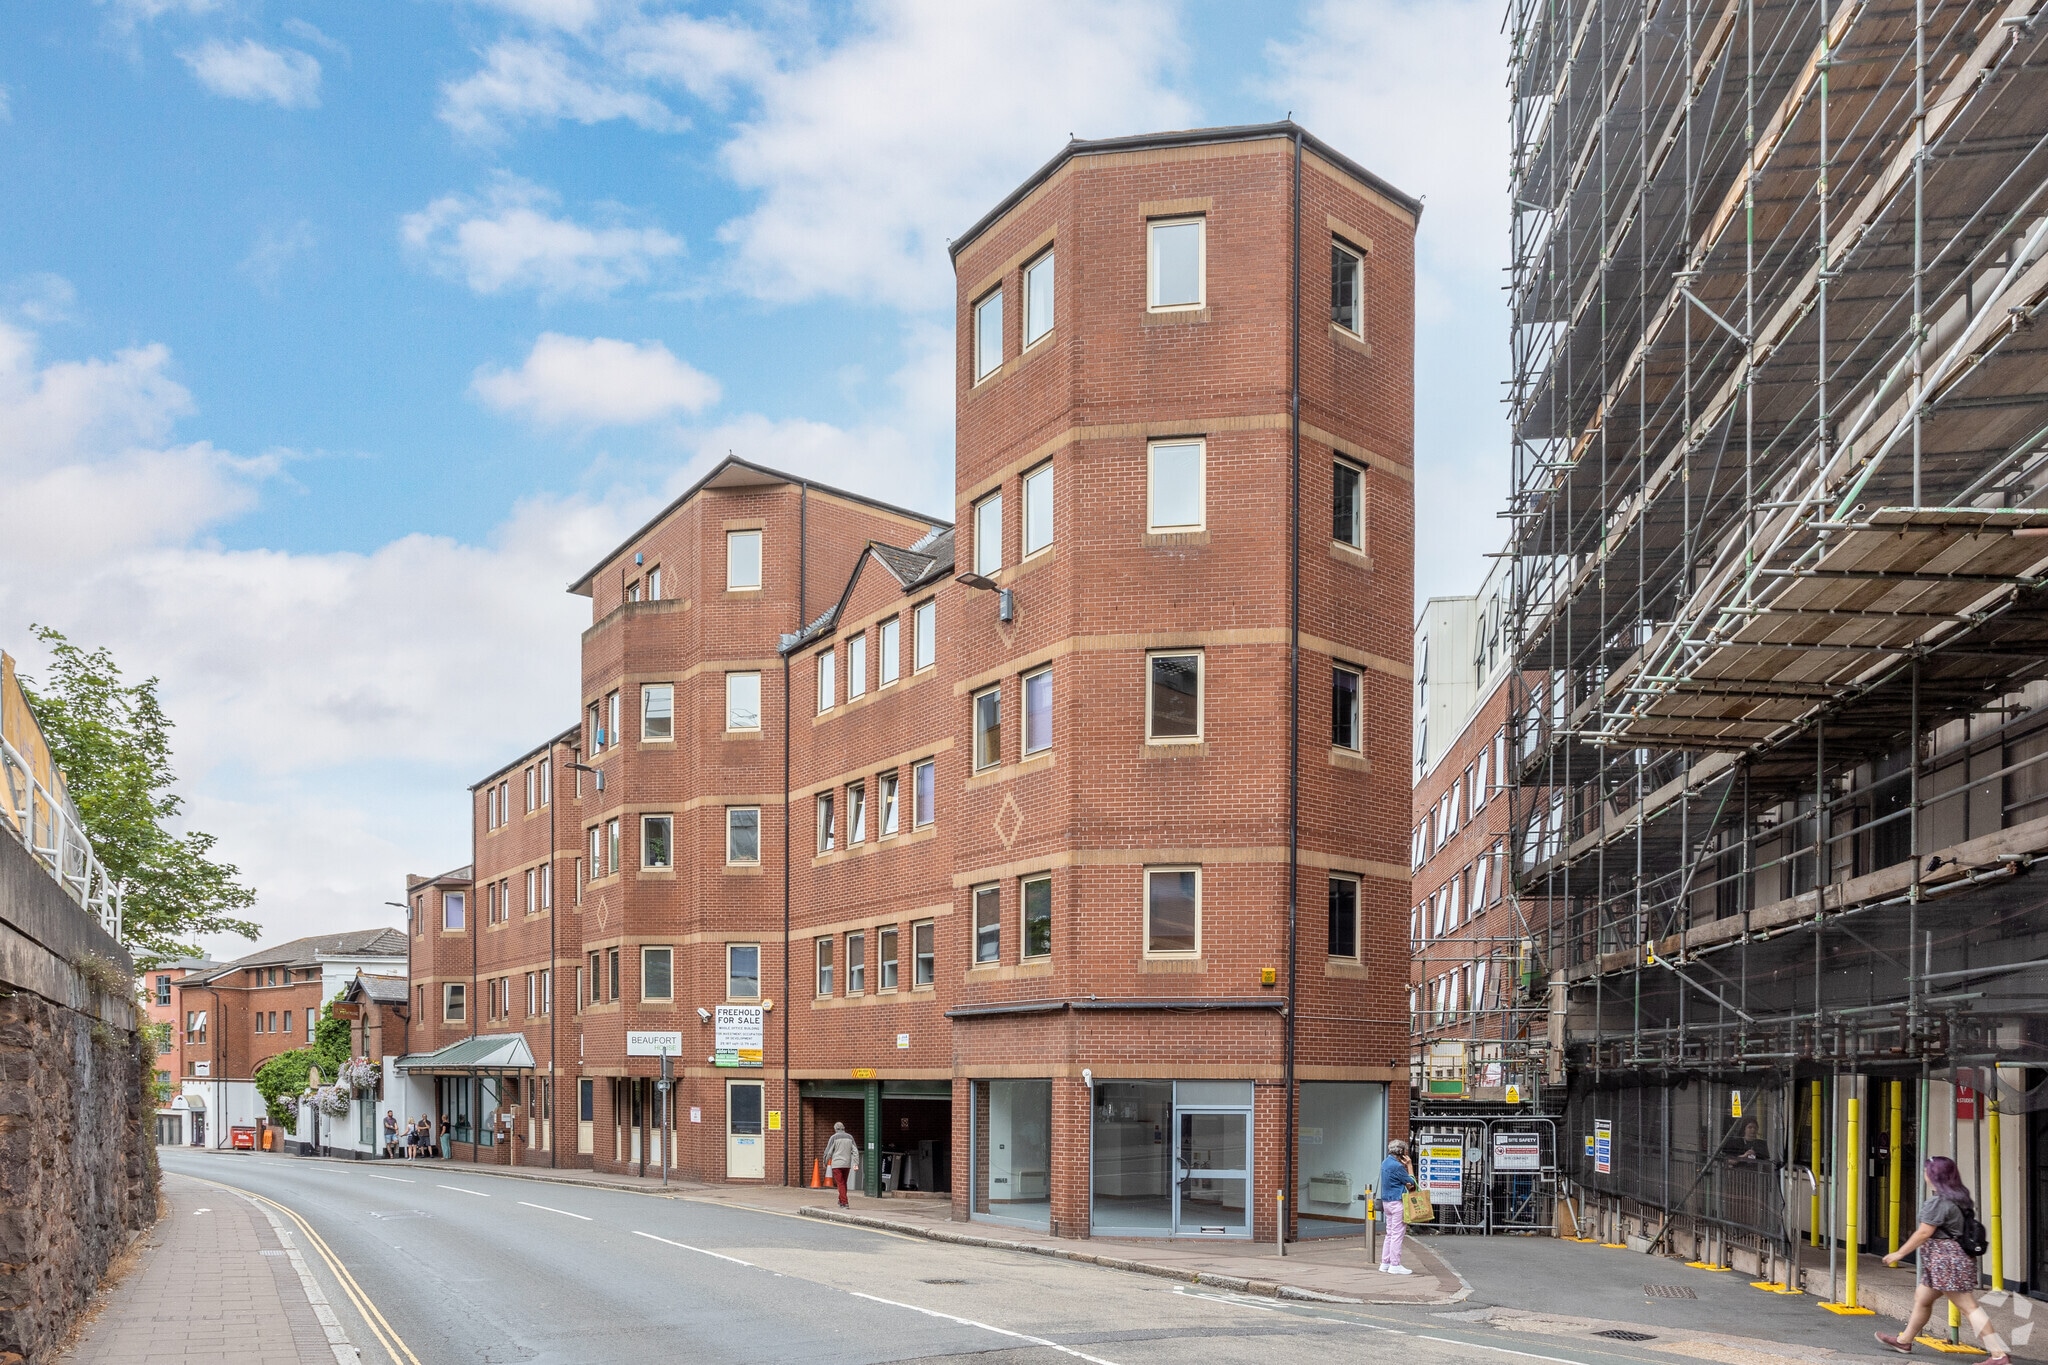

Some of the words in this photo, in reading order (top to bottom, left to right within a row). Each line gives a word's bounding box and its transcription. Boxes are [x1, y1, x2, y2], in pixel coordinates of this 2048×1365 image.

[717, 1008, 761, 1016] FREEHOLD
[717, 1016, 734, 1024] FOR
[631, 1036, 677, 1044] BEAUFORT
